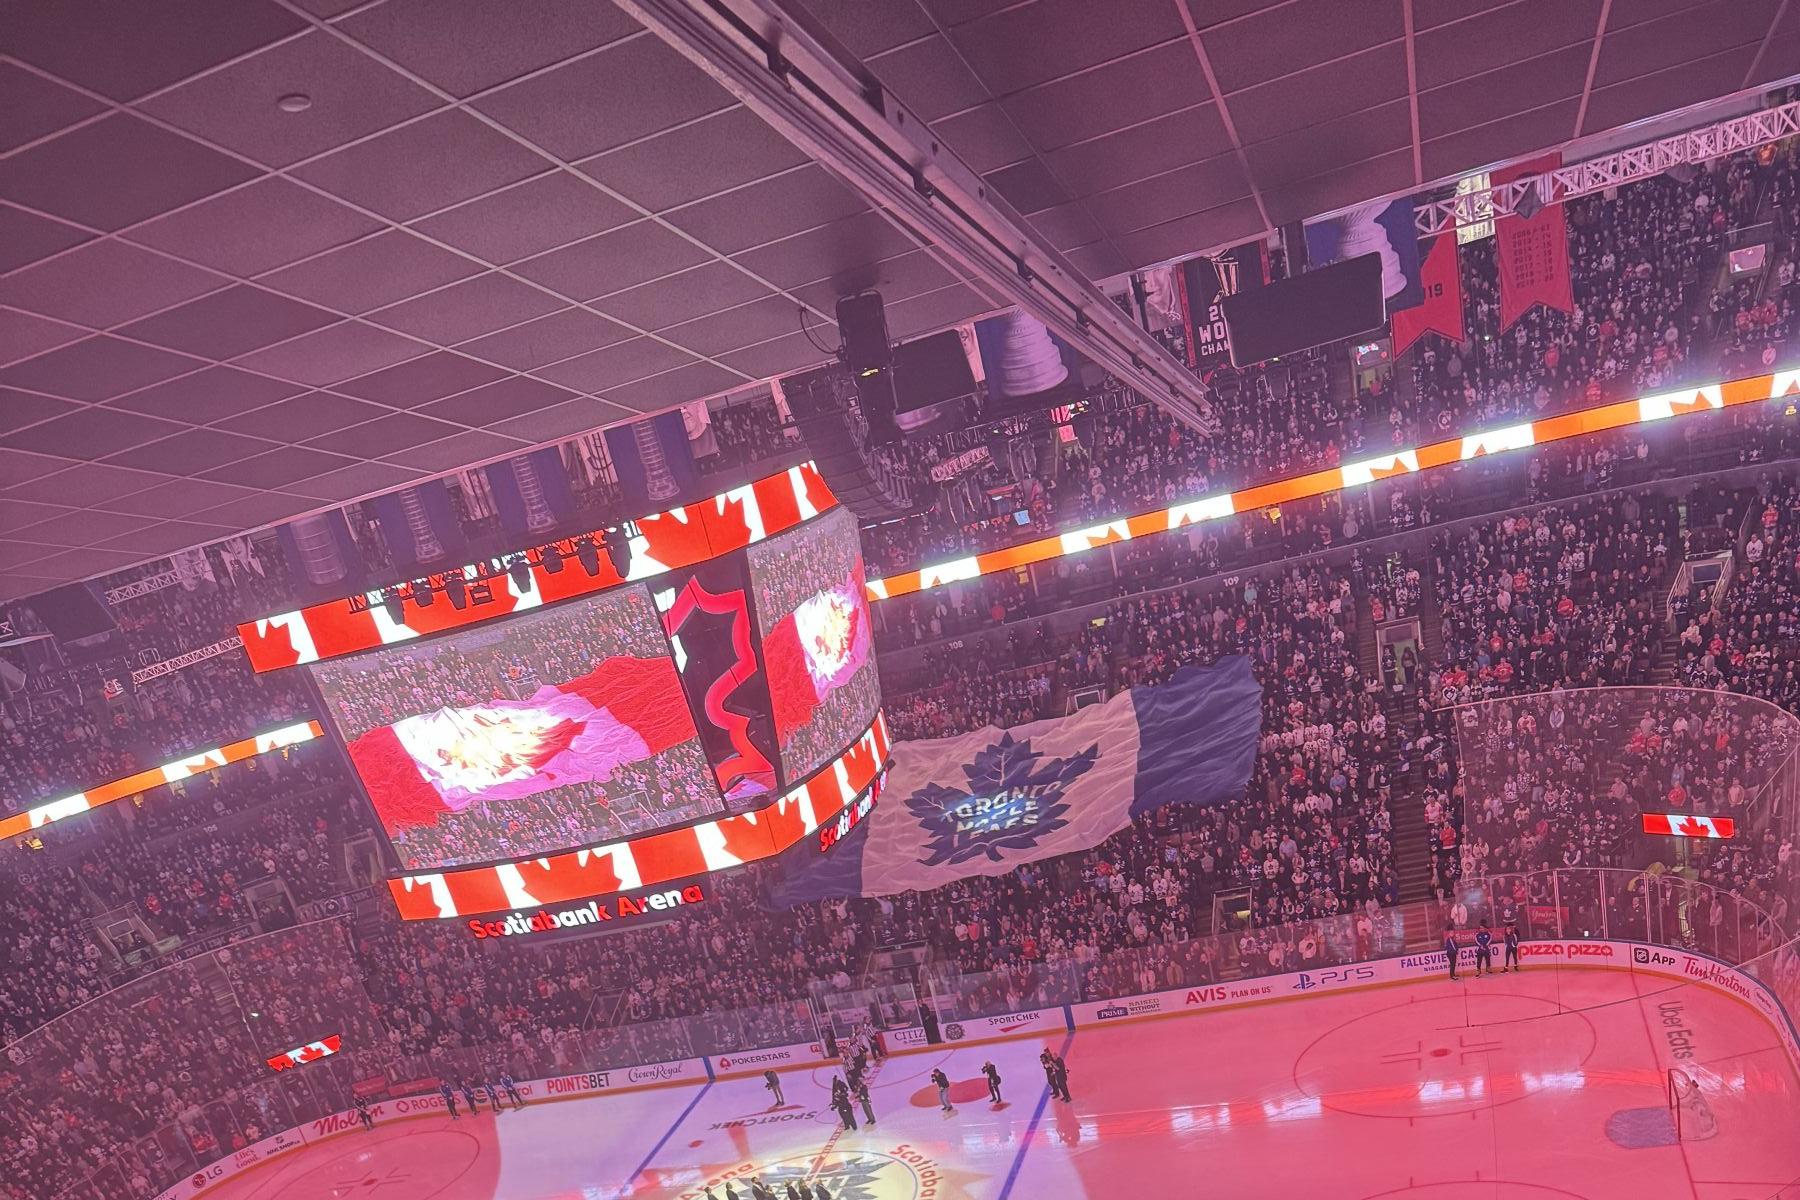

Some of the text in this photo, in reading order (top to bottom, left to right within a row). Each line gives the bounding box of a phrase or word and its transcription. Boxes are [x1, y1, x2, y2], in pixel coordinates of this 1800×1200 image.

[1223, 576, 1239, 587] 109
[468, 884, 704, 938] Scotiabank Arena
[1518, 943, 1613, 960] pizza pizza
[1401, 953, 1448, 969] FALLSVIE
[1424, 964, 1450, 972] NIAGAR
[1320, 966, 1375, 985] PS5
[1683, 956, 1751, 999] Tim Hortons
[1186, 986, 1272, 1004] AVIS PLAN ON US
[894, 1028, 926, 1042] CITIZ
[1658, 1001, 1695, 1060] Uber Eats
[731, 1051, 790, 1065] POKERSTARS
[546, 1073, 610, 1093] POINTSBET
[411, 1095, 460, 1110] ROGES
[206, 1165, 223, 1180] LG
